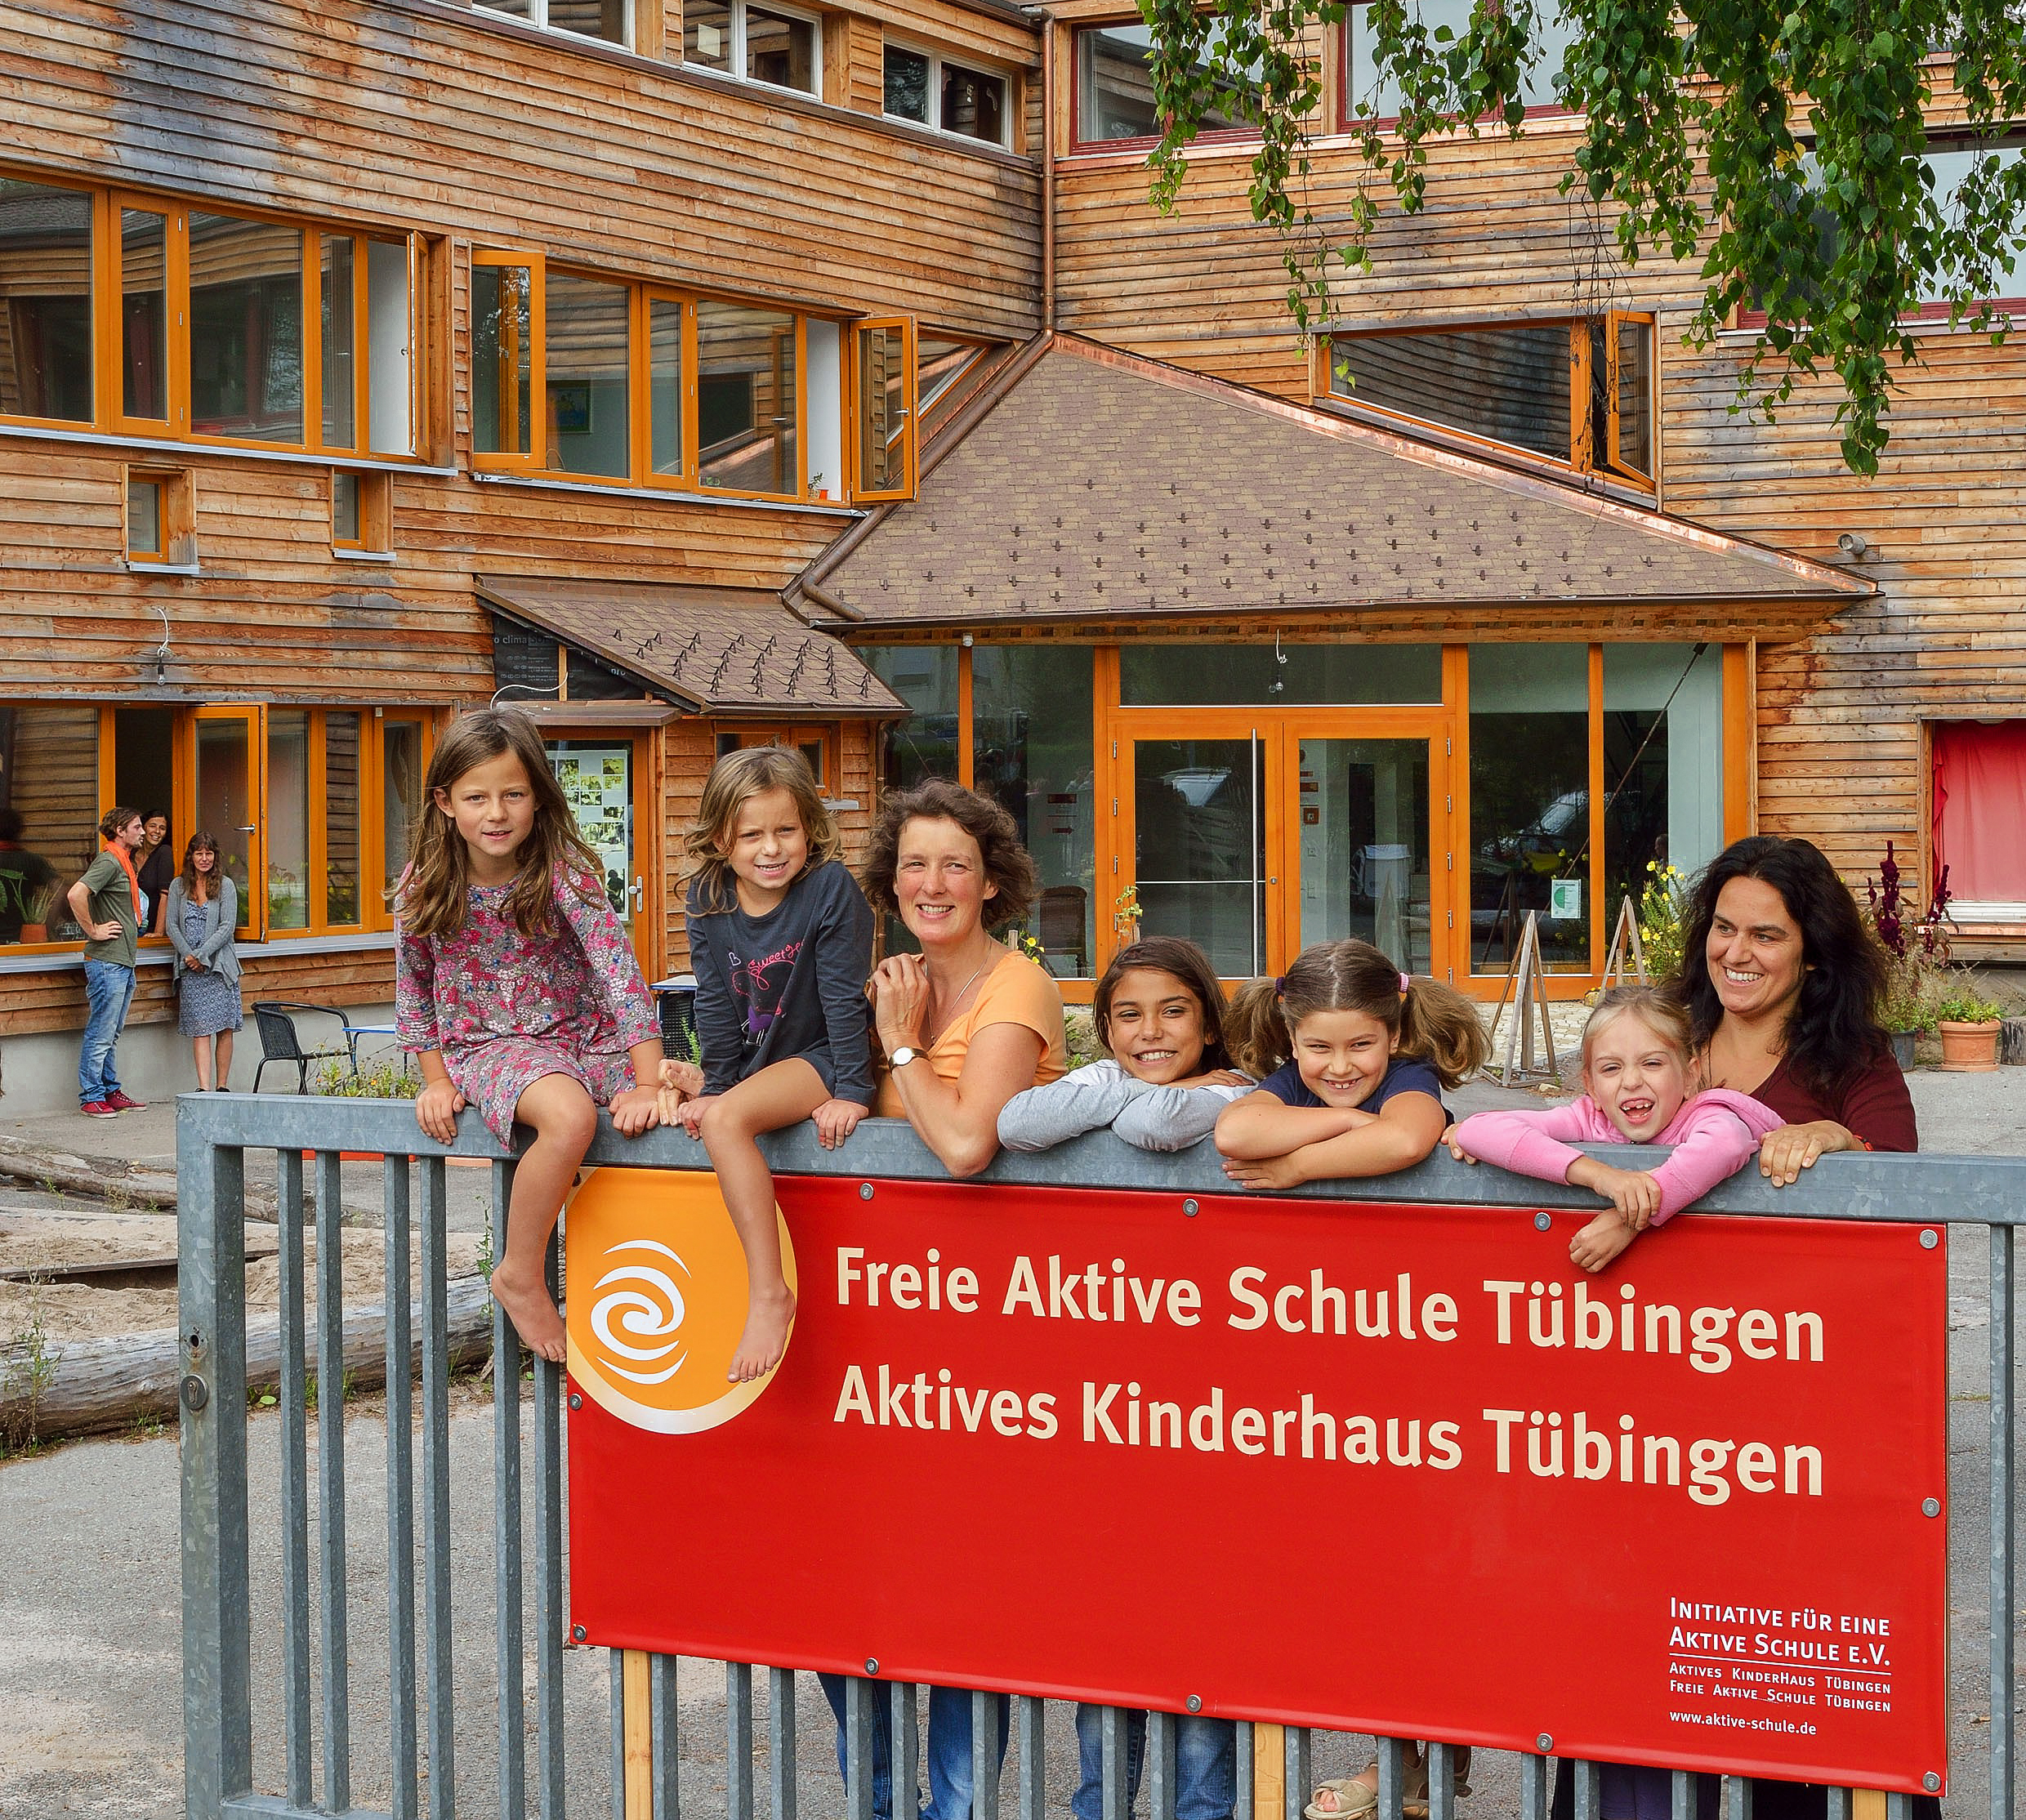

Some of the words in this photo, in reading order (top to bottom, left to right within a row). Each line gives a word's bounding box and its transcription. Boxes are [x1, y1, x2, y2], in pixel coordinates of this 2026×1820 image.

[502, 635, 528, 644] clima
[838, 1247, 979, 1312] Freie
[1002, 1255, 1201, 1326] Aktive
[1228, 1267, 1457, 1341] Schule
[1484, 1280, 1823, 1373] Tübingen
[834, 1364, 1058, 1439] Aktives
[1083, 1382, 1461, 1470] Kinderhaus
[1484, 1409, 1822, 1506] Tübingen
[1669, 1711, 1817, 1735] www.aktive-schule.de
